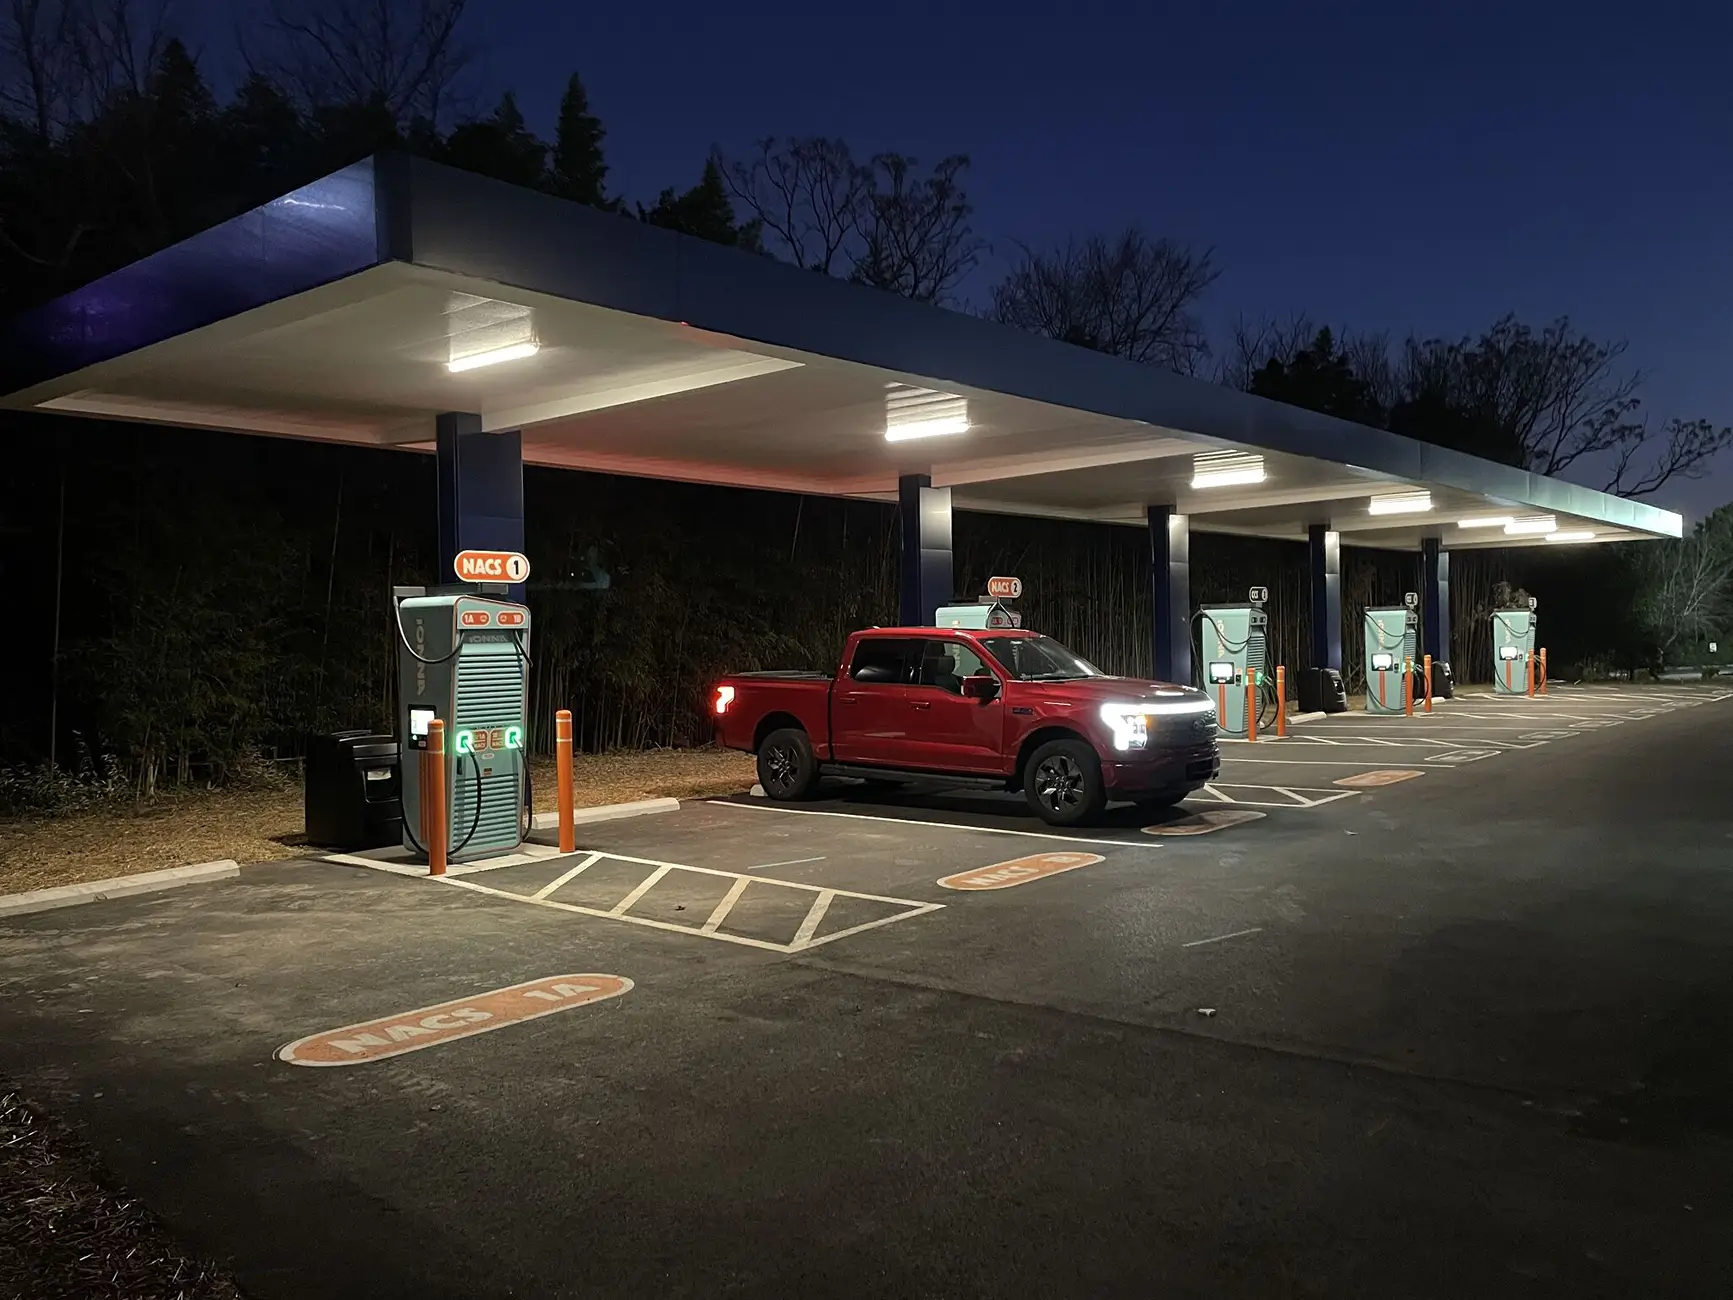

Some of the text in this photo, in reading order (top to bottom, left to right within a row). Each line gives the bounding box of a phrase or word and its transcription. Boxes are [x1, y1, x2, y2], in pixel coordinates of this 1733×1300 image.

[462, 557, 519, 576] NACS 1
[991, 581, 1018, 593] NACS 2
[464, 614, 475, 624] 1A
[328, 983, 601, 1053] NACS 1A
